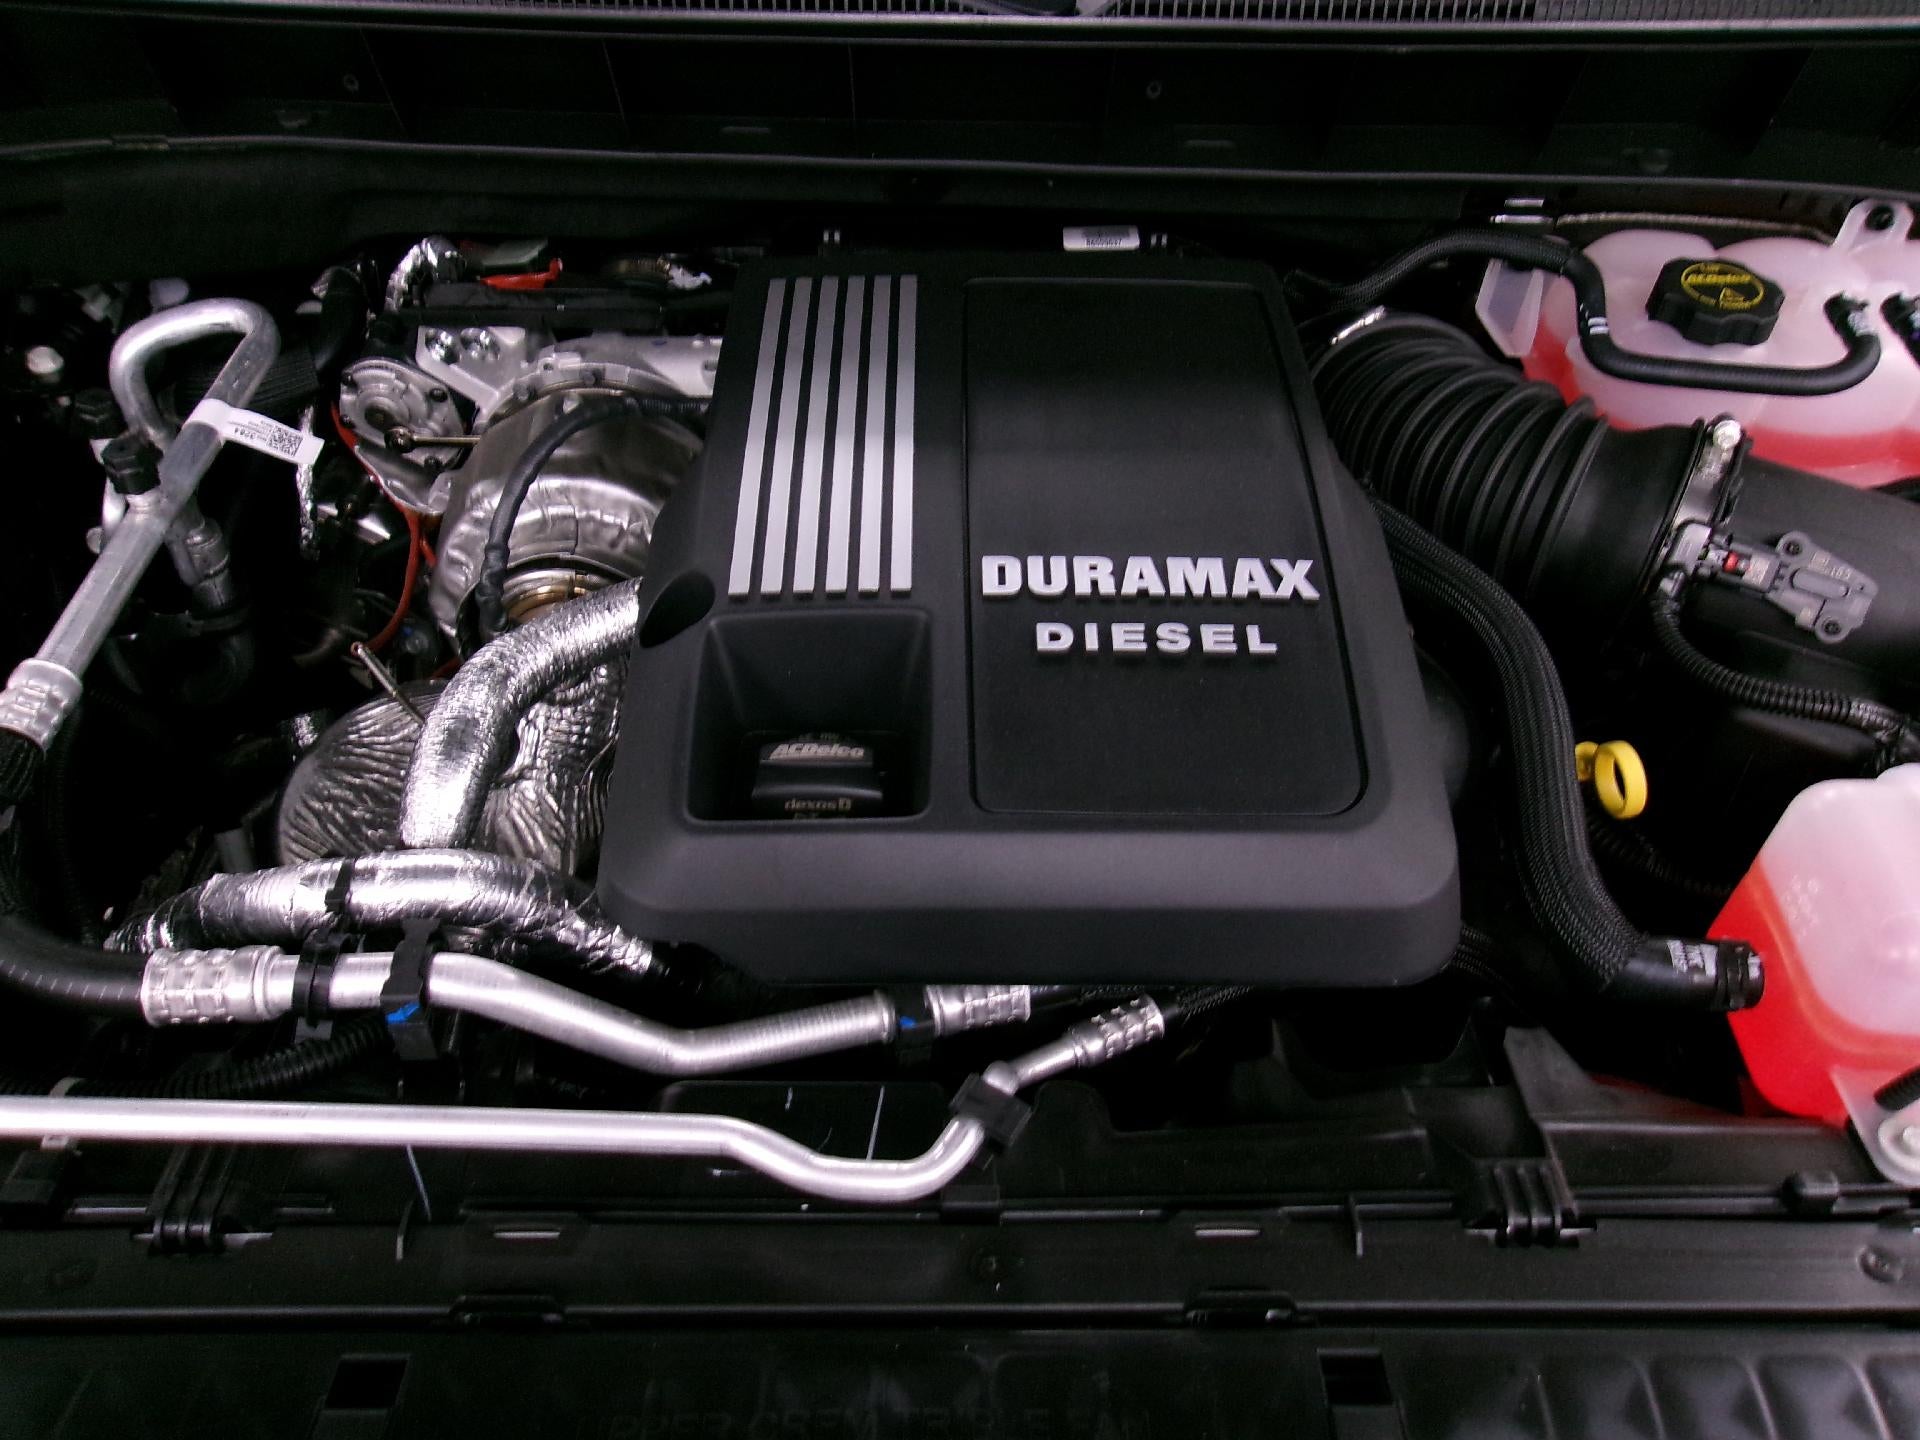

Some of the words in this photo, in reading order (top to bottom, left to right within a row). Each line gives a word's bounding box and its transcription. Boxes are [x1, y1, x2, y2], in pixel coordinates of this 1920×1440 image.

[981, 554, 1320, 600] DURAMAX
[1035, 622, 1278, 655] DIESEL
[769, 742, 865, 760] ACDelco
